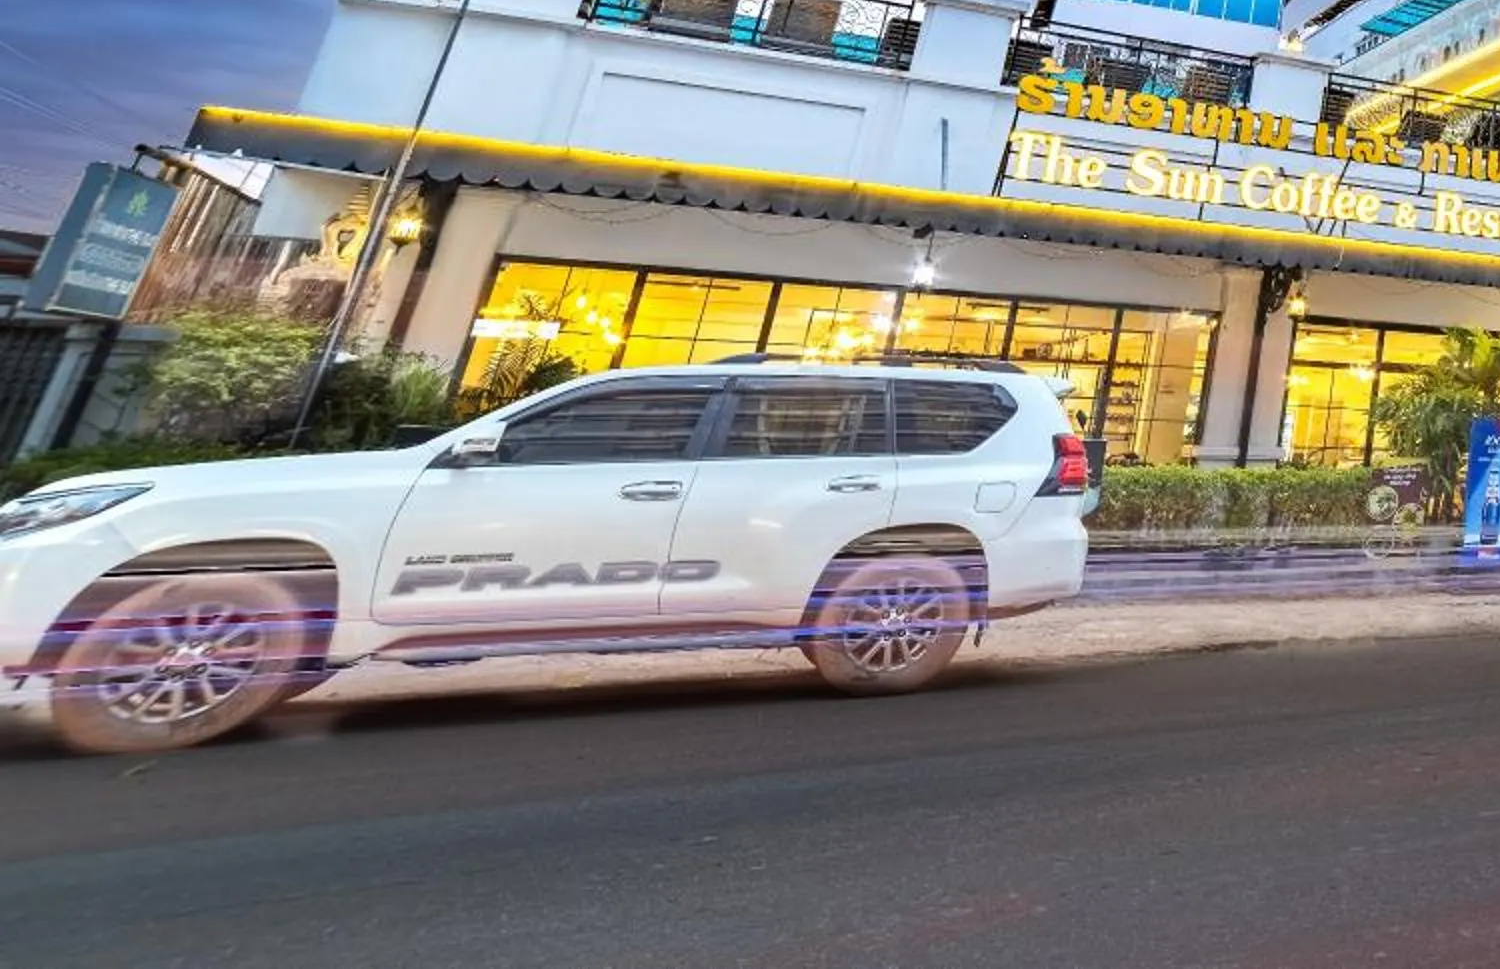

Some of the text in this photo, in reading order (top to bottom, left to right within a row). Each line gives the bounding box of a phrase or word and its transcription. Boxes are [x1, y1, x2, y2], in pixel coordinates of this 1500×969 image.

[1313, 121, 1405, 164] ແລະ
[1009, 129, 1107, 188] The
[1125, 147, 1225, 205] Sun
[1239, 163, 1381, 225] Coffee
[1395, 199, 1418, 228] &
[390, 560, 721, 594] PRADO
